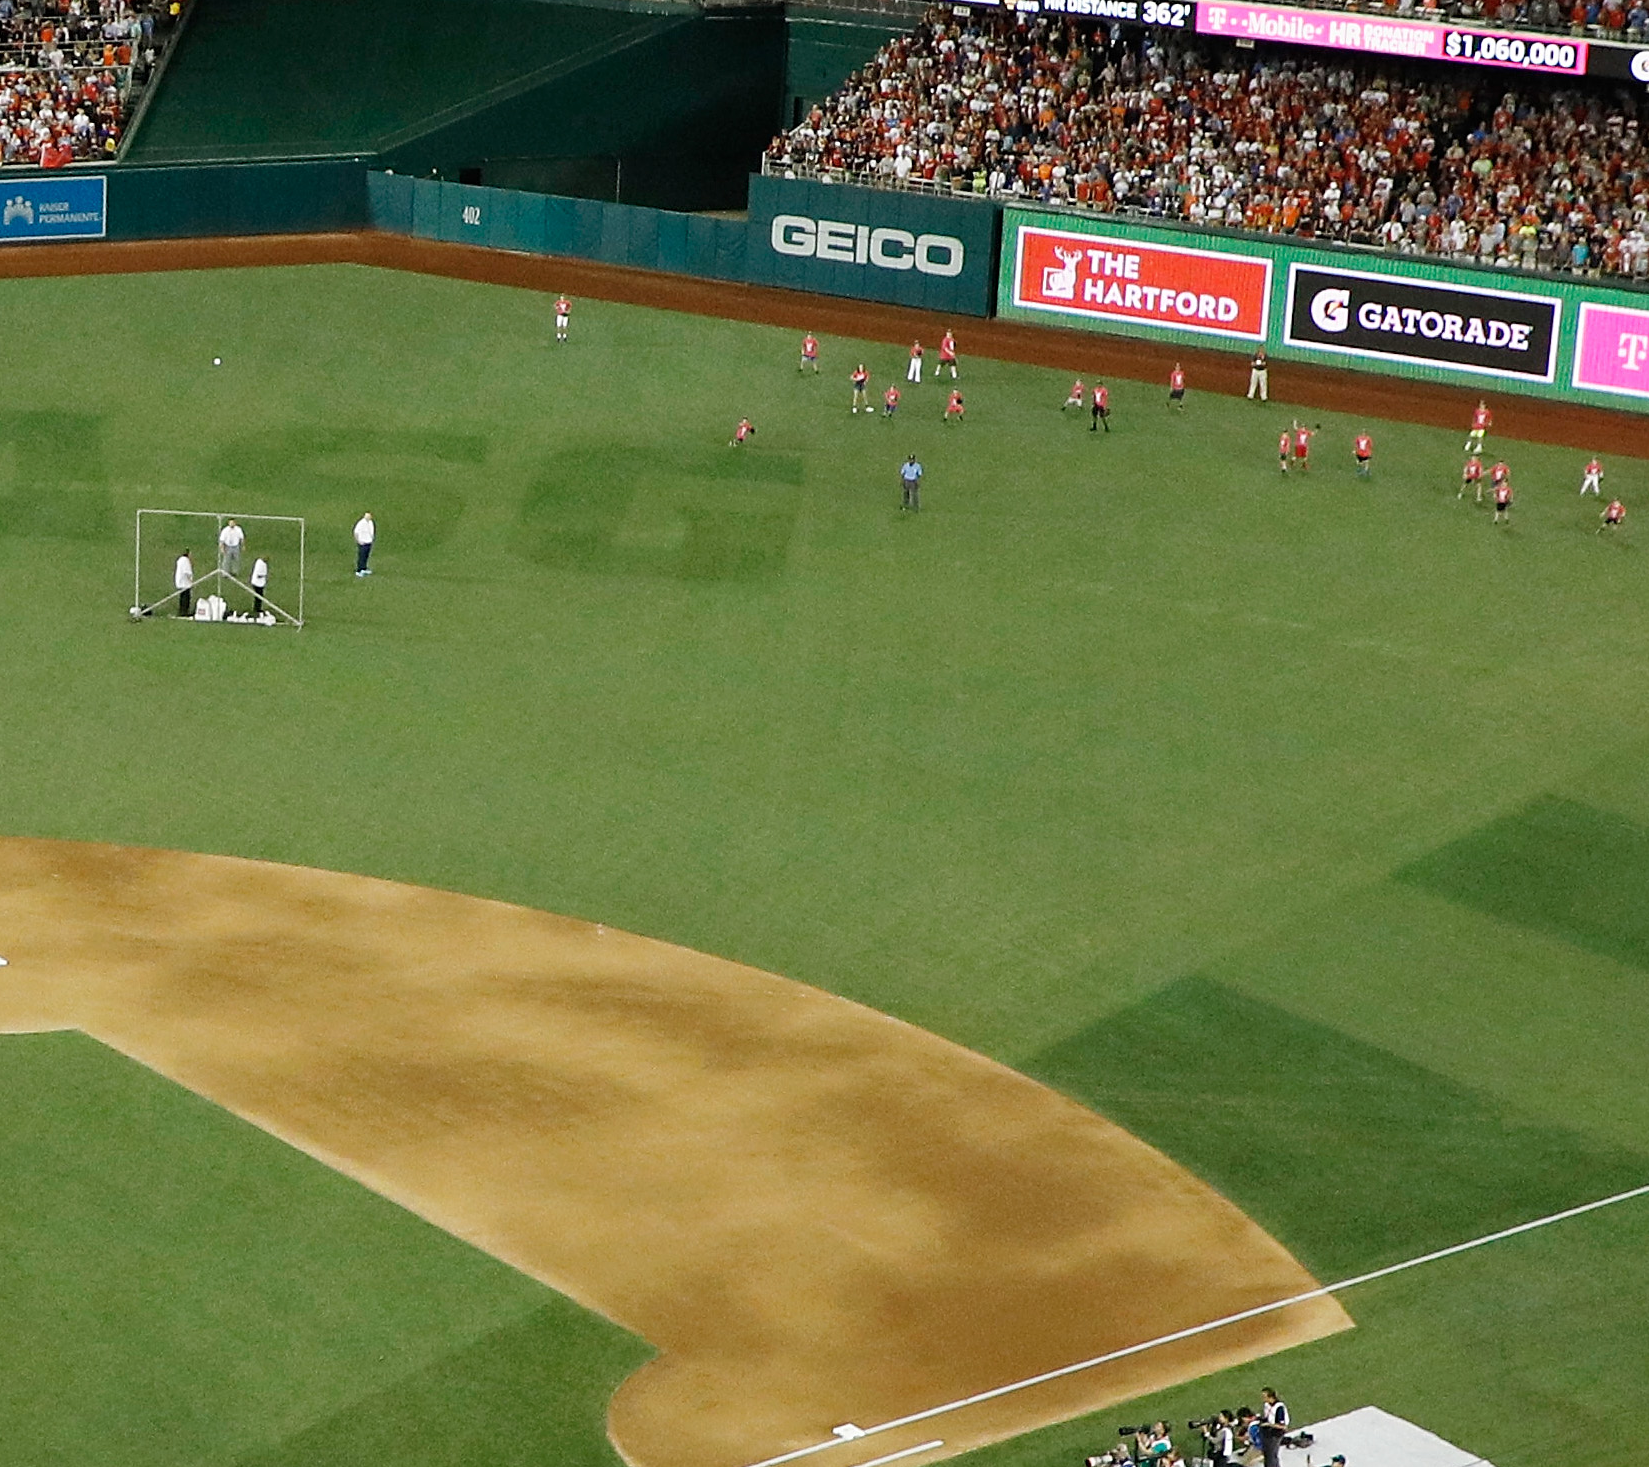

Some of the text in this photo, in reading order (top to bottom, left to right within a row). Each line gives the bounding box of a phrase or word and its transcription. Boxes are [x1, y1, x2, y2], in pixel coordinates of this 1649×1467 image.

[1142, 0, 1191, 27] 362'
[1329, 21, 1362, 47] HR
[1444, 31, 1575, 68] $1,060,000
[461, 205, 481, 225] 402
[771, 212, 965, 279] GEICO
[1086, 247, 1141, 282] THE
[1082, 278, 1239, 324] HARTFORD
[1358, 300, 1533, 352] GATORADE
